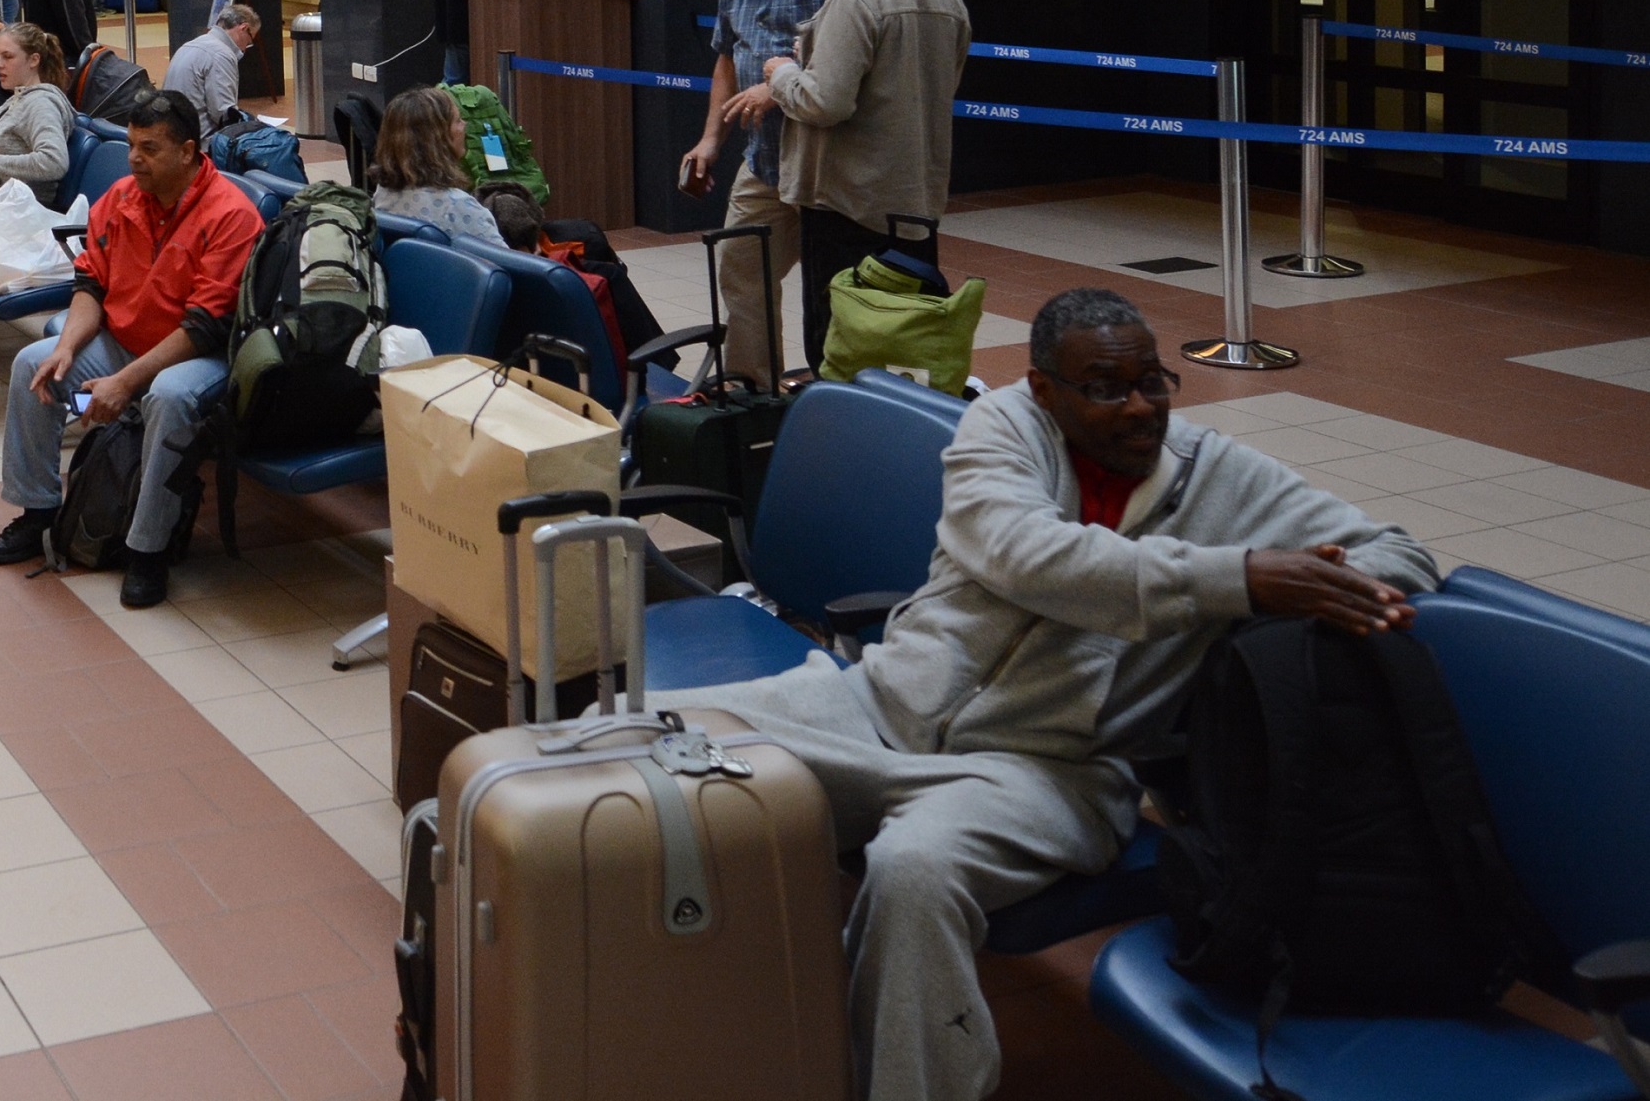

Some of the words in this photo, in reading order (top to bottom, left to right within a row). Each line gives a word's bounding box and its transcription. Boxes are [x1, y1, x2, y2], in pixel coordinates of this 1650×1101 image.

[993, 47, 1009, 57] 724
[1010, 48, 1030, 59] AMS
[1096, 55, 1113, 66] 724
[1114, 57, 1136, 68] AMS
[1375, 28, 1392, 39] 724
[1395, 30, 1417, 41] AMS
[1494, 41, 1512, 52] 724
[1514, 43, 1539, 55] AMS
[1626, 54, 1646, 65] 724
[562, 66, 576, 76] 724
[576, 67, 594, 78] AMS
[656, 76, 670, 86] 724
[672, 77, 691, 88] AMS
[965, 103, 987, 116] 724
[989, 105, 1019, 119] AMS
[1123, 117, 1148, 129] 724
[1150, 119, 1183, 132] AMS
[1299, 129, 1325, 142] 724
[1328, 131, 1365, 144] AMS
[1494, 139, 1524, 153] 724
[1528, 140, 1568, 155] AMS
[400, 501, 481, 555] BURBERRY
